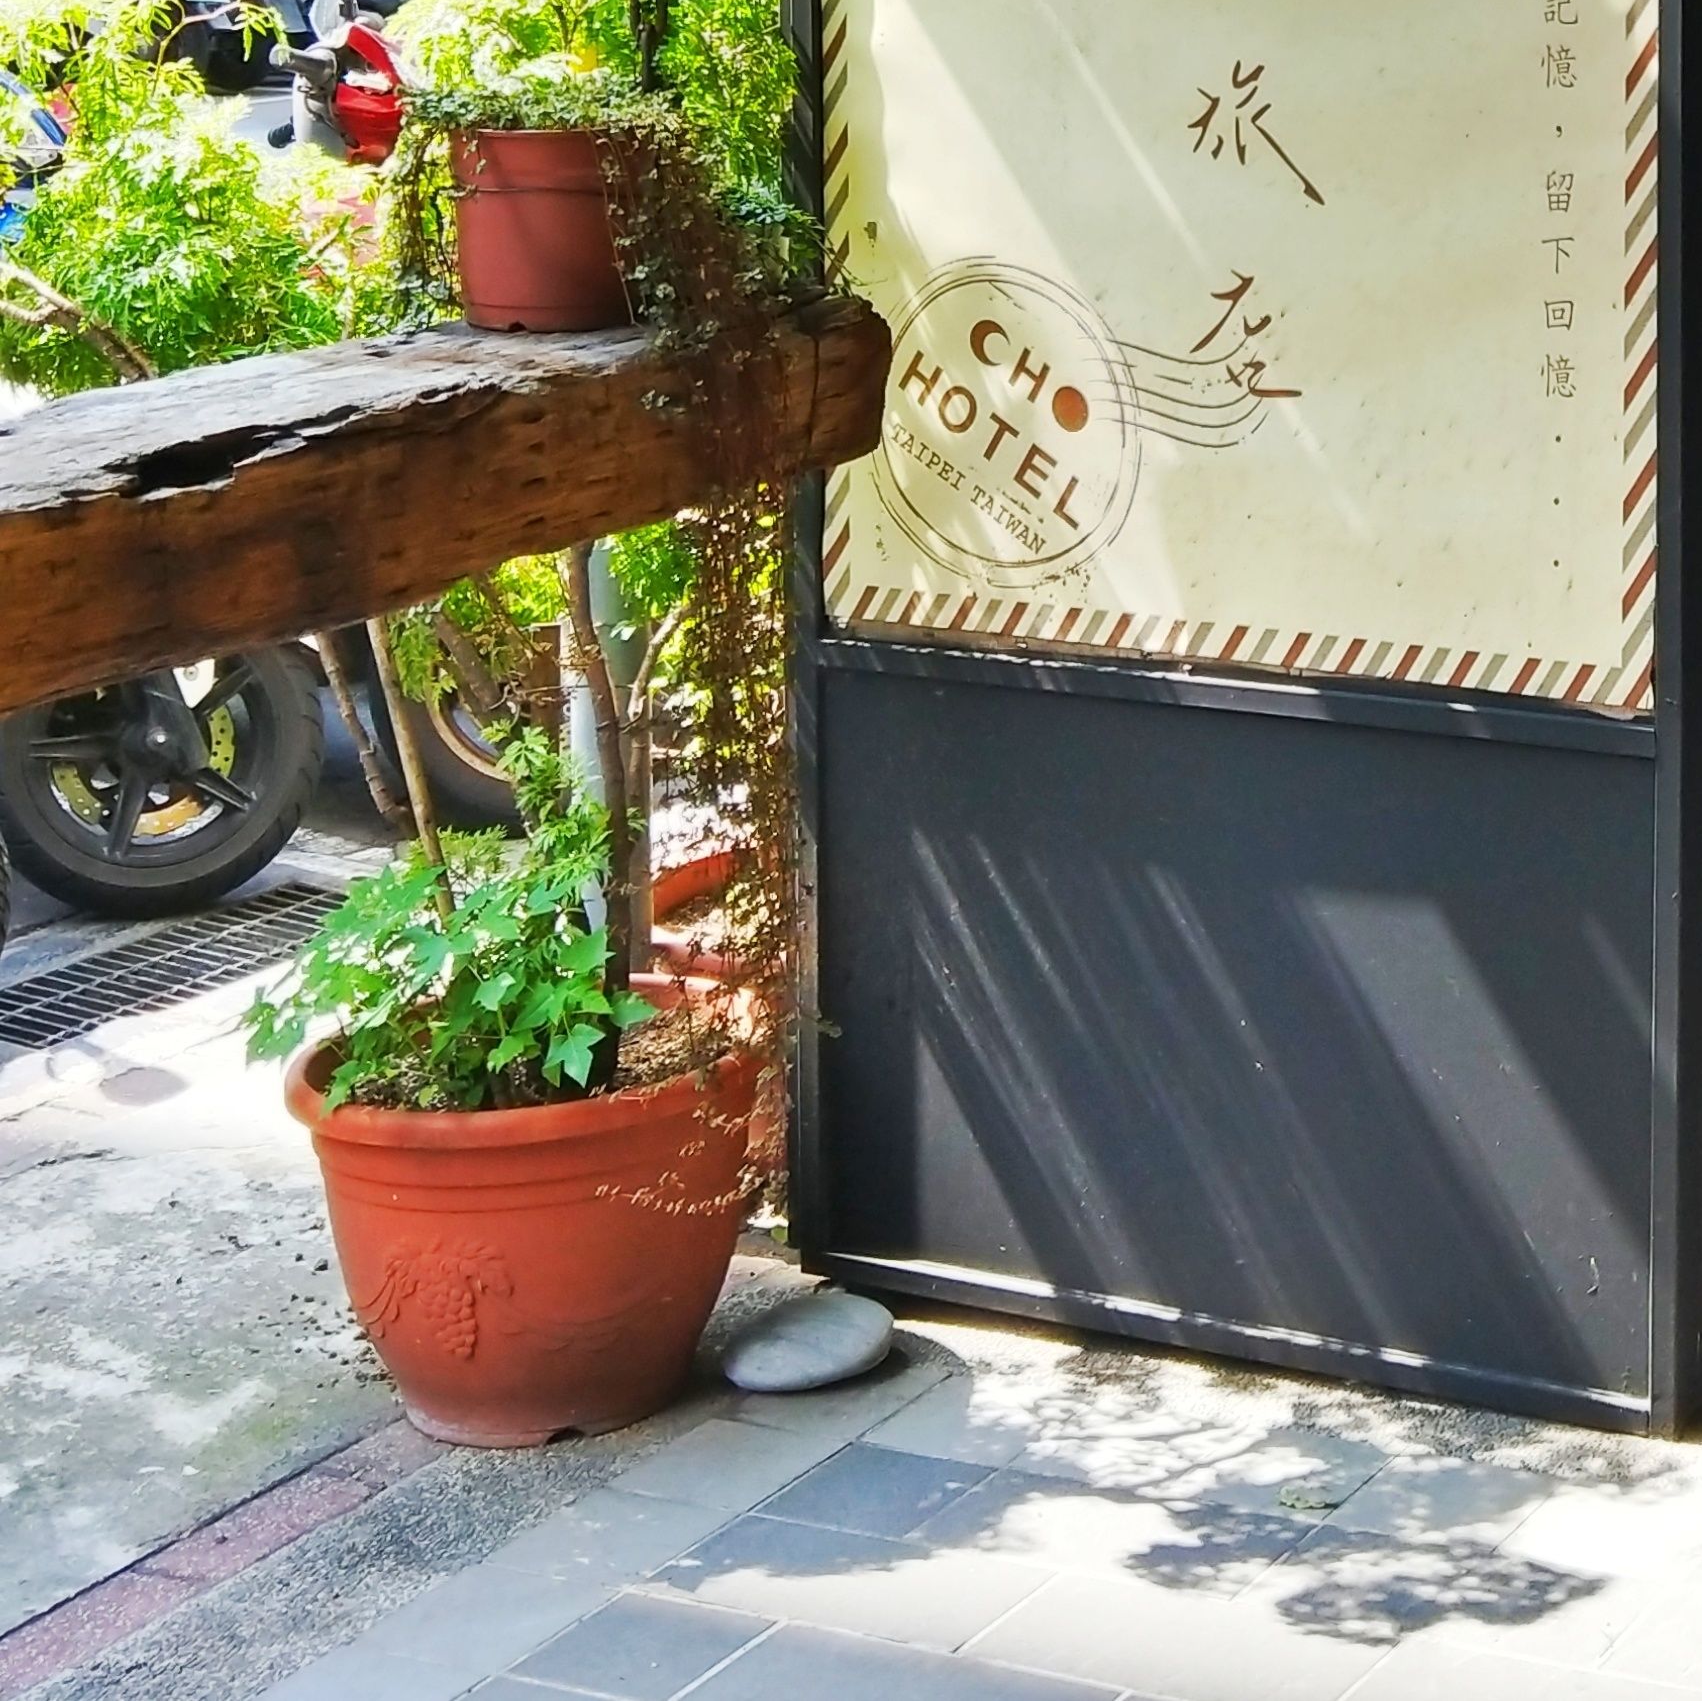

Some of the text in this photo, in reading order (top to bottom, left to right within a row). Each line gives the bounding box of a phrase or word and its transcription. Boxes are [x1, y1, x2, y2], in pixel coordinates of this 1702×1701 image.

[889, 422, 1047, 555] TAIPEI TAIWAN
[898, 349, 1082, 531] HOTEL
